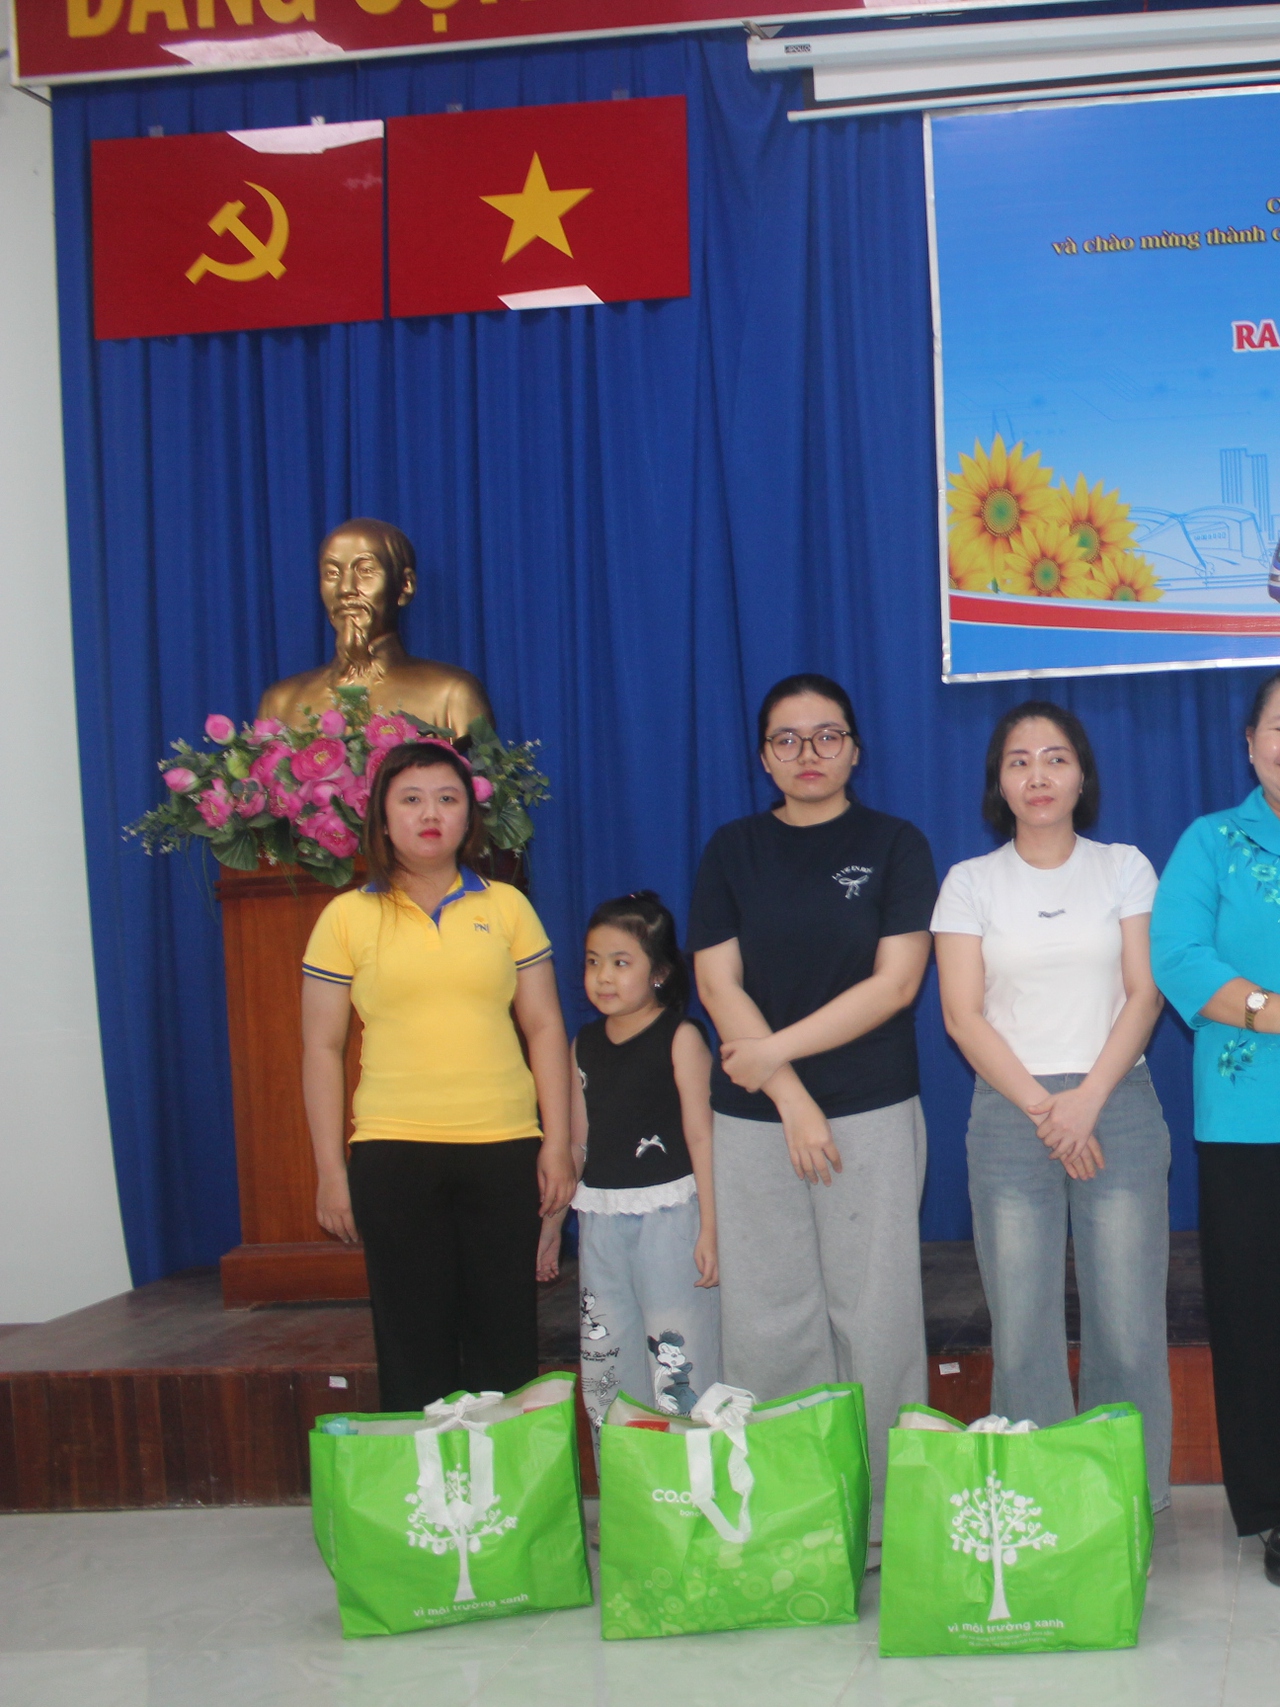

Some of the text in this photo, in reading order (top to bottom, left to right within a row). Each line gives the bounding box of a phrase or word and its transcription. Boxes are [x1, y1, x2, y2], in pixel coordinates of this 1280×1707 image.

[1052, 237, 1077, 255] và
[1083, 233, 1134, 253] chào
[1140, 230, 1201, 250] mừng
[1205, 226, 1266, 246] thành
[413, 1593, 528, 1617] vì môi trường xanh
[948, 1619, 1064, 1633] vì môi trường xanh
